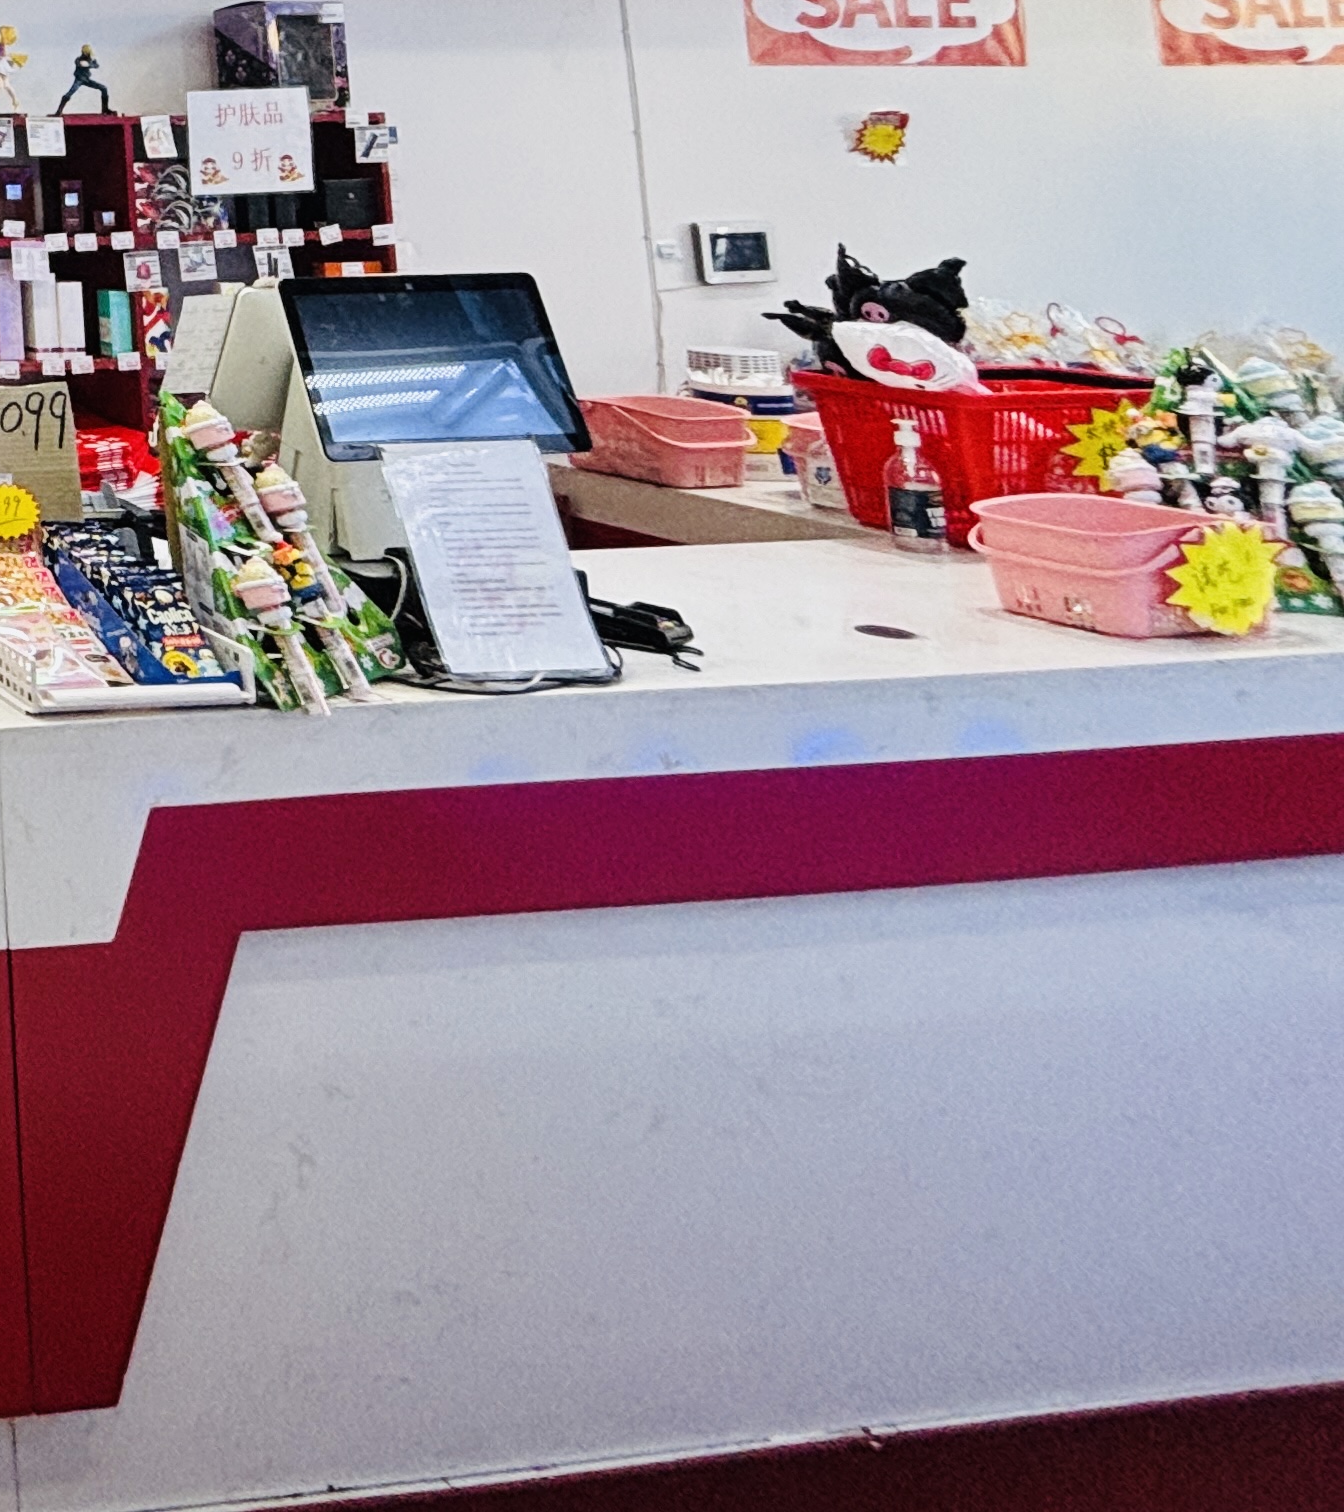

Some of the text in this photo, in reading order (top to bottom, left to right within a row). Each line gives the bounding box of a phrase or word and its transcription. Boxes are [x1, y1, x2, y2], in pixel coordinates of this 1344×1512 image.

[215, 101, 283, 128] 护肤品
[232, 147, 273, 172] 9 折
